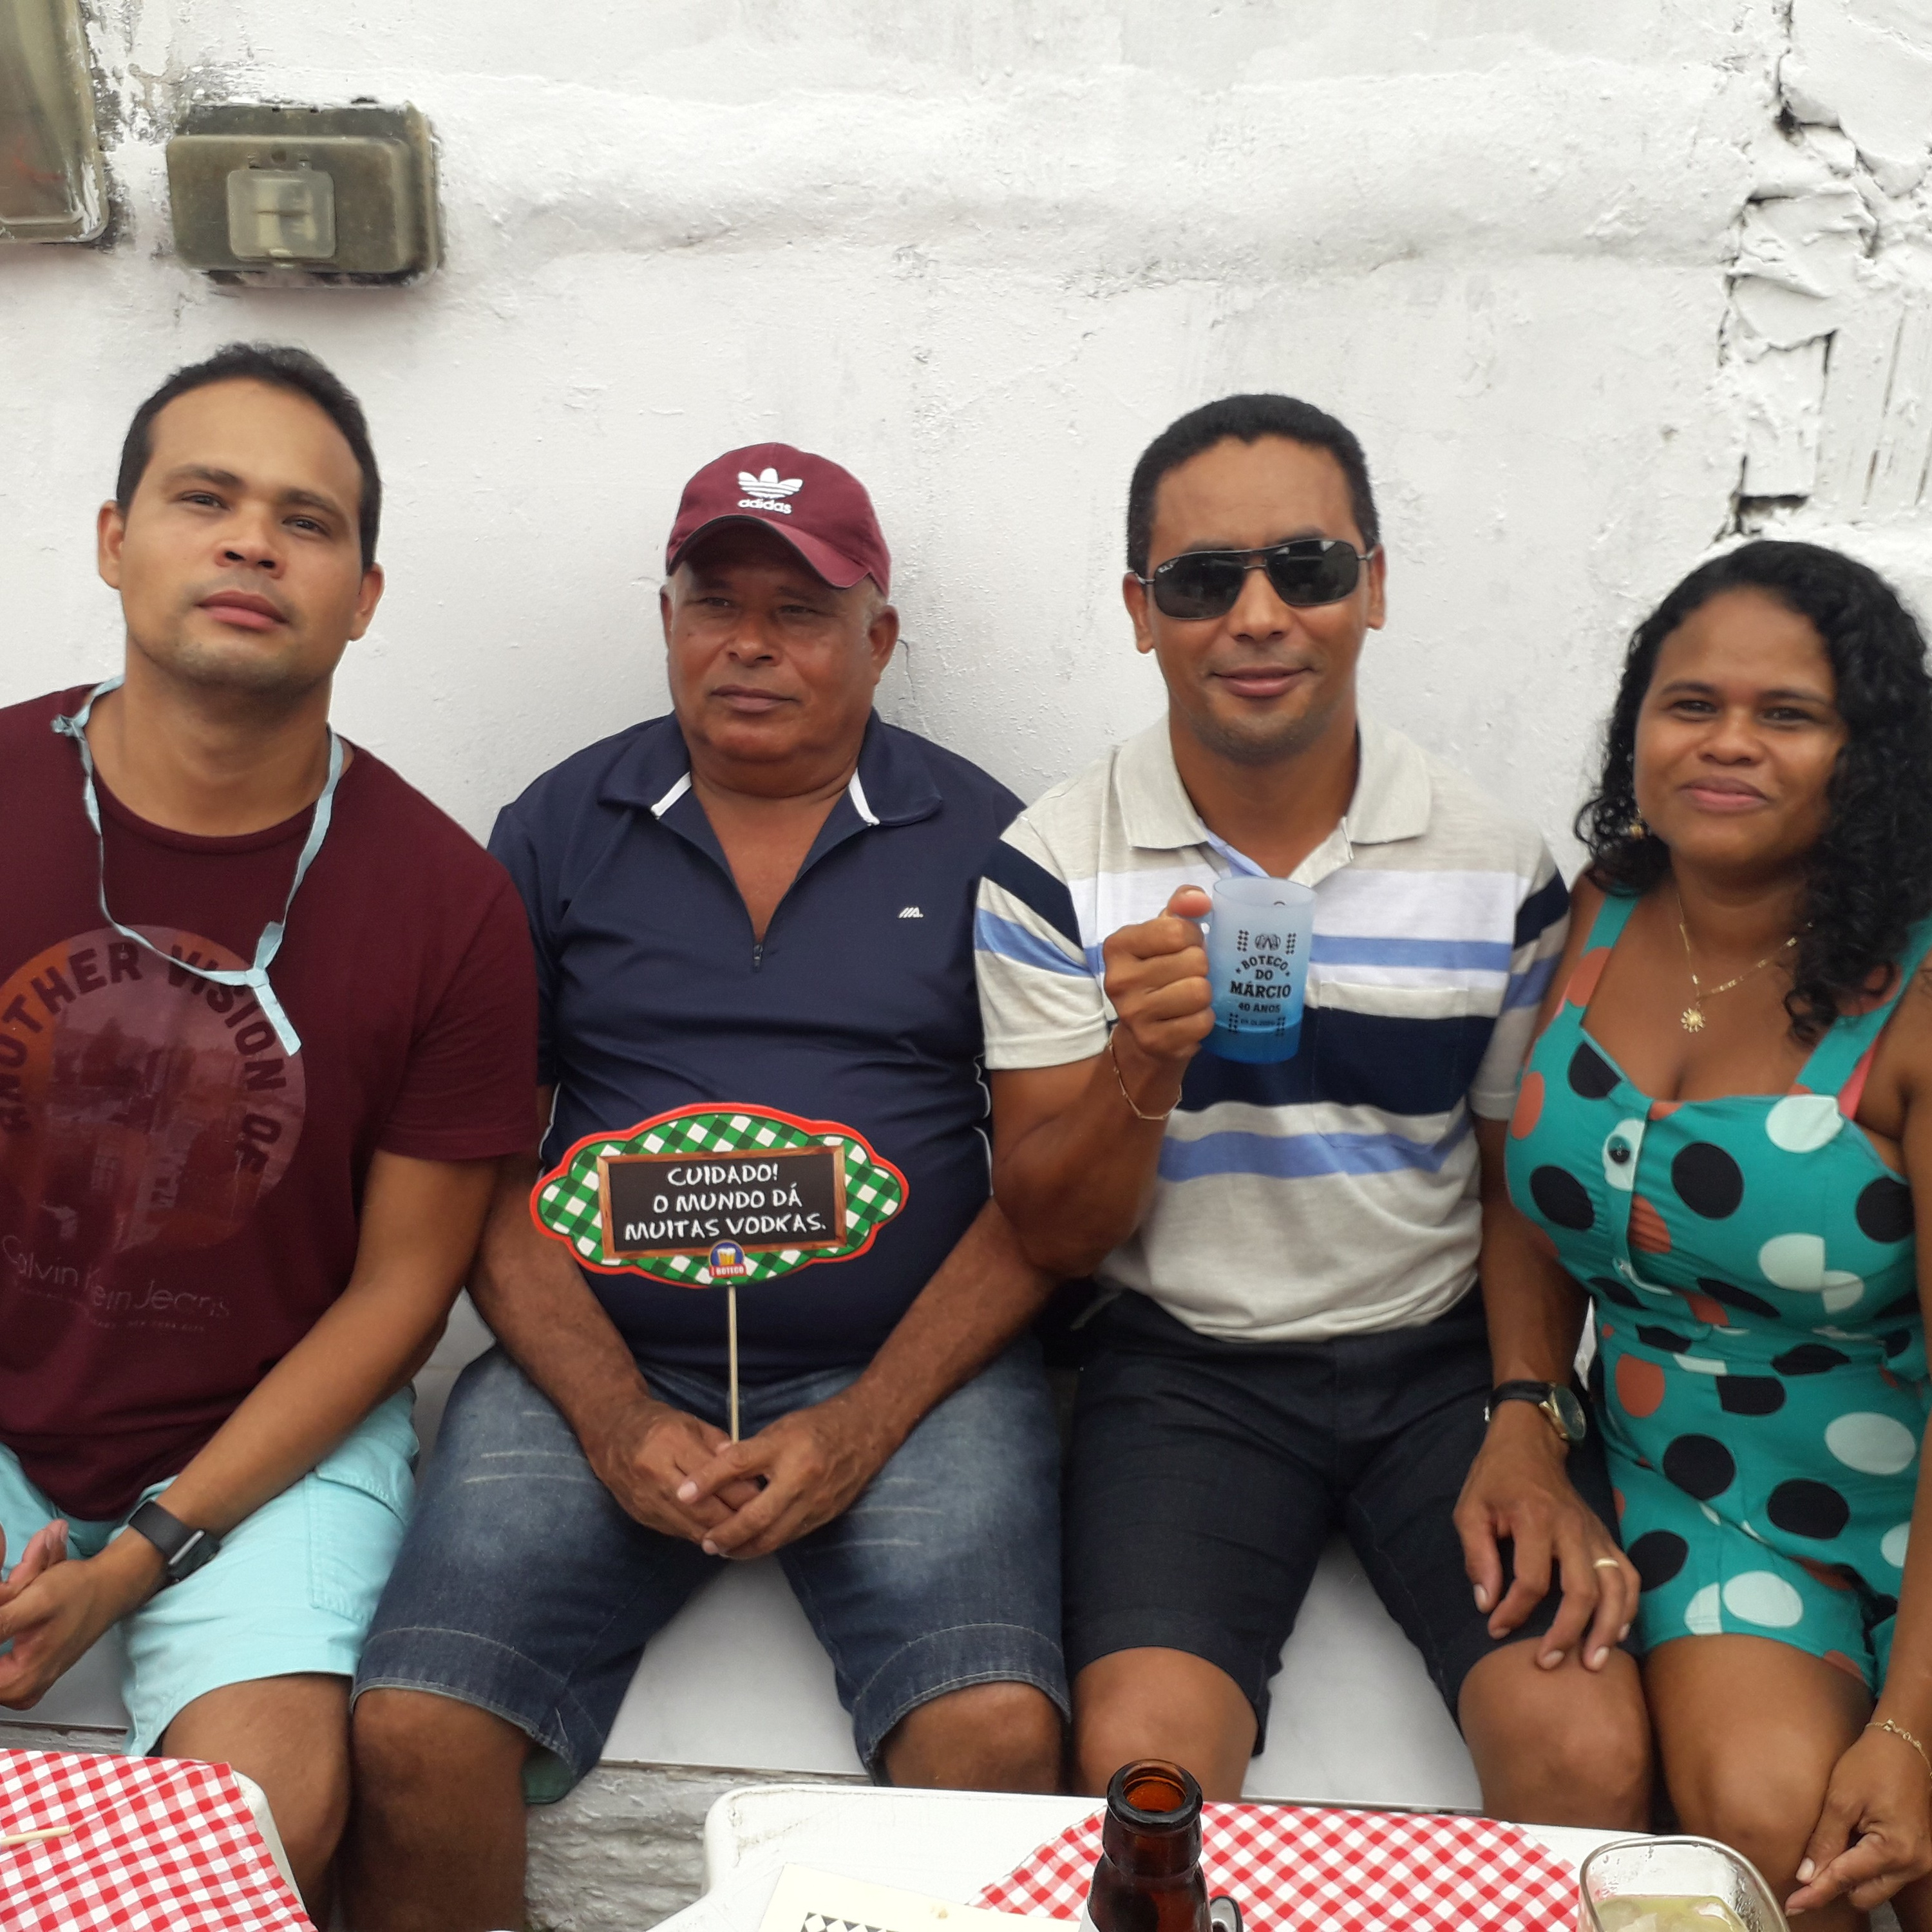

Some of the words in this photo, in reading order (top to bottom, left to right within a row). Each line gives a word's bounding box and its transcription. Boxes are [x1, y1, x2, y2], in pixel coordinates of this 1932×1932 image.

[737, 498, 791, 514] adidas
[1241, 955, 1289, 971] BOTECO
[1256, 969, 1273, 980] DO
[1230, 981, 1292, 998] MÁRCIO
[167, 944, 287, 1092] VISION
[1238, 1003, 1250, 1011] 40
[1253, 1003, 1280, 1013] ANOS
[667, 1163, 779, 1186] CUIDADO!
[653, 1195, 668, 1213] O
[676, 1190, 765, 1212] MUNDO
[772, 1182, 802, 1208] DÁ
[625, 1218, 720, 1240] MUITAS
[725, 1213, 826, 1235] VODKAS.
[1, 1235, 78, 1287] Calvin
